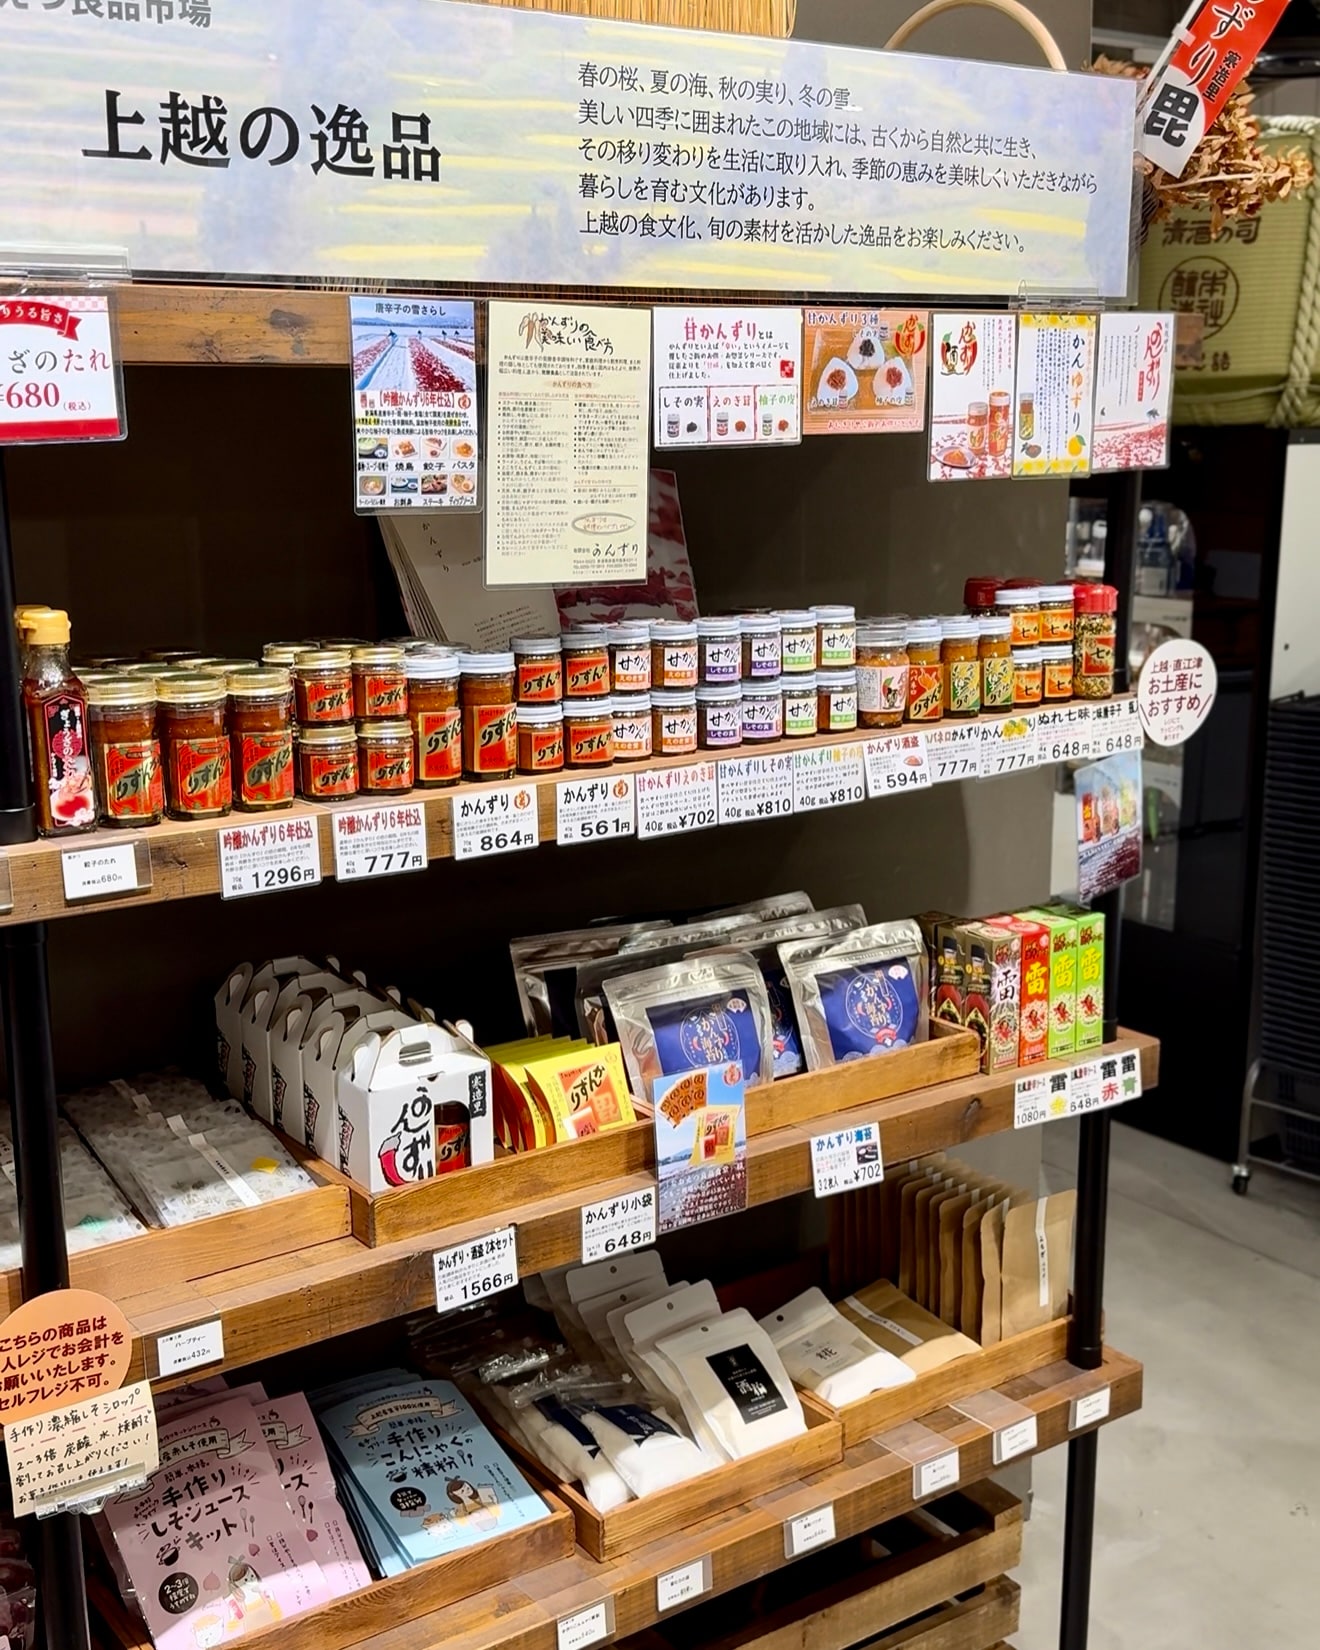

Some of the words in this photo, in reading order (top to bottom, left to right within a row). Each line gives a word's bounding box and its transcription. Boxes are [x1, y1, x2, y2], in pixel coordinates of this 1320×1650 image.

[82, 90, 443, 182] 上越の逸品
[577, 99, 1038, 161] 美しい四季に囲まれたこの地域には、古くから自然と共に生き、
[577, 137, 1098, 194] その移り変わりを生活に取り入れ、季節の恵みを美味しくいただきながら
[578, 173, 817, 212] 暮らしを育む文化があります。
[579, 211, 1026, 254] 上越の食文化、旬の素材を活かした逸品をお楽しみください。
[375, 302, 447, 317] 唐辛子の雪さらし
[540, 328, 615, 356] 美味しい食べ方
[8, 348, 111, 375] ざのたれ
[663, 395, 705, 409] しその実
[451, 460, 476, 470] パスタ
[1148, 672, 1203, 695] お土産に
[1037, 707, 1091, 726] ぬれ七味
[1148, 693, 1201, 718] おすすめ
[867, 735, 920, 755] かんずり酒盗
[1052, 741, 1090, 759] 648円
[1106, 735, 1142, 753] 648円
[719, 756, 793, 780] 甘かんずりしその実
[937, 759, 977, 777] 777円
[996, 753, 1035, 772] 777円
[637, 765, 715, 793] 甘かんずりえのき茸
[886, 770, 928, 789] 594円
[563, 782, 609, 805] かんずり
[830, 785, 863, 804] ¥810
[460, 793, 510, 819] かんずり
[757, 798, 791, 816] ¥810
[580, 817, 631, 838] 561円
[679, 809, 715, 829] ¥702
[480, 830, 534, 852] 864円
[364, 851, 423, 874] 777円
[252, 865, 315, 889] 1296円
[1054, 954, 1076, 989] 雷
[1080, 947, 1102, 981] 雷
[1025, 961, 1048, 996] 雷
[1048, 1072, 1068, 1094] 雷
[1100, 1059, 1118, 1081] 雷
[1121, 1054, 1137, 1075] 雷
[1101, 1081, 1120, 1103] 赤
[1016, 1110, 1047, 1126] 1080円
[853, 1163, 881, 1182] ¥702
[585, 1192, 653, 1225] かんずり小袋
[604, 1230, 653, 1253] 648円
[461, 1272, 514, 1300] 1566円
[1, 1331, 124, 1374] 人レジでお会計を
[0, 1353, 116, 1392] 願いいたします。
[387, 1425, 442, 1448] 手作り
[413, 1455, 461, 1481] 精粉
[162, 1467, 228, 1509] 手作り
[151, 1484, 251, 1538] しそジュース
[185, 1517, 238, 1551] キット
